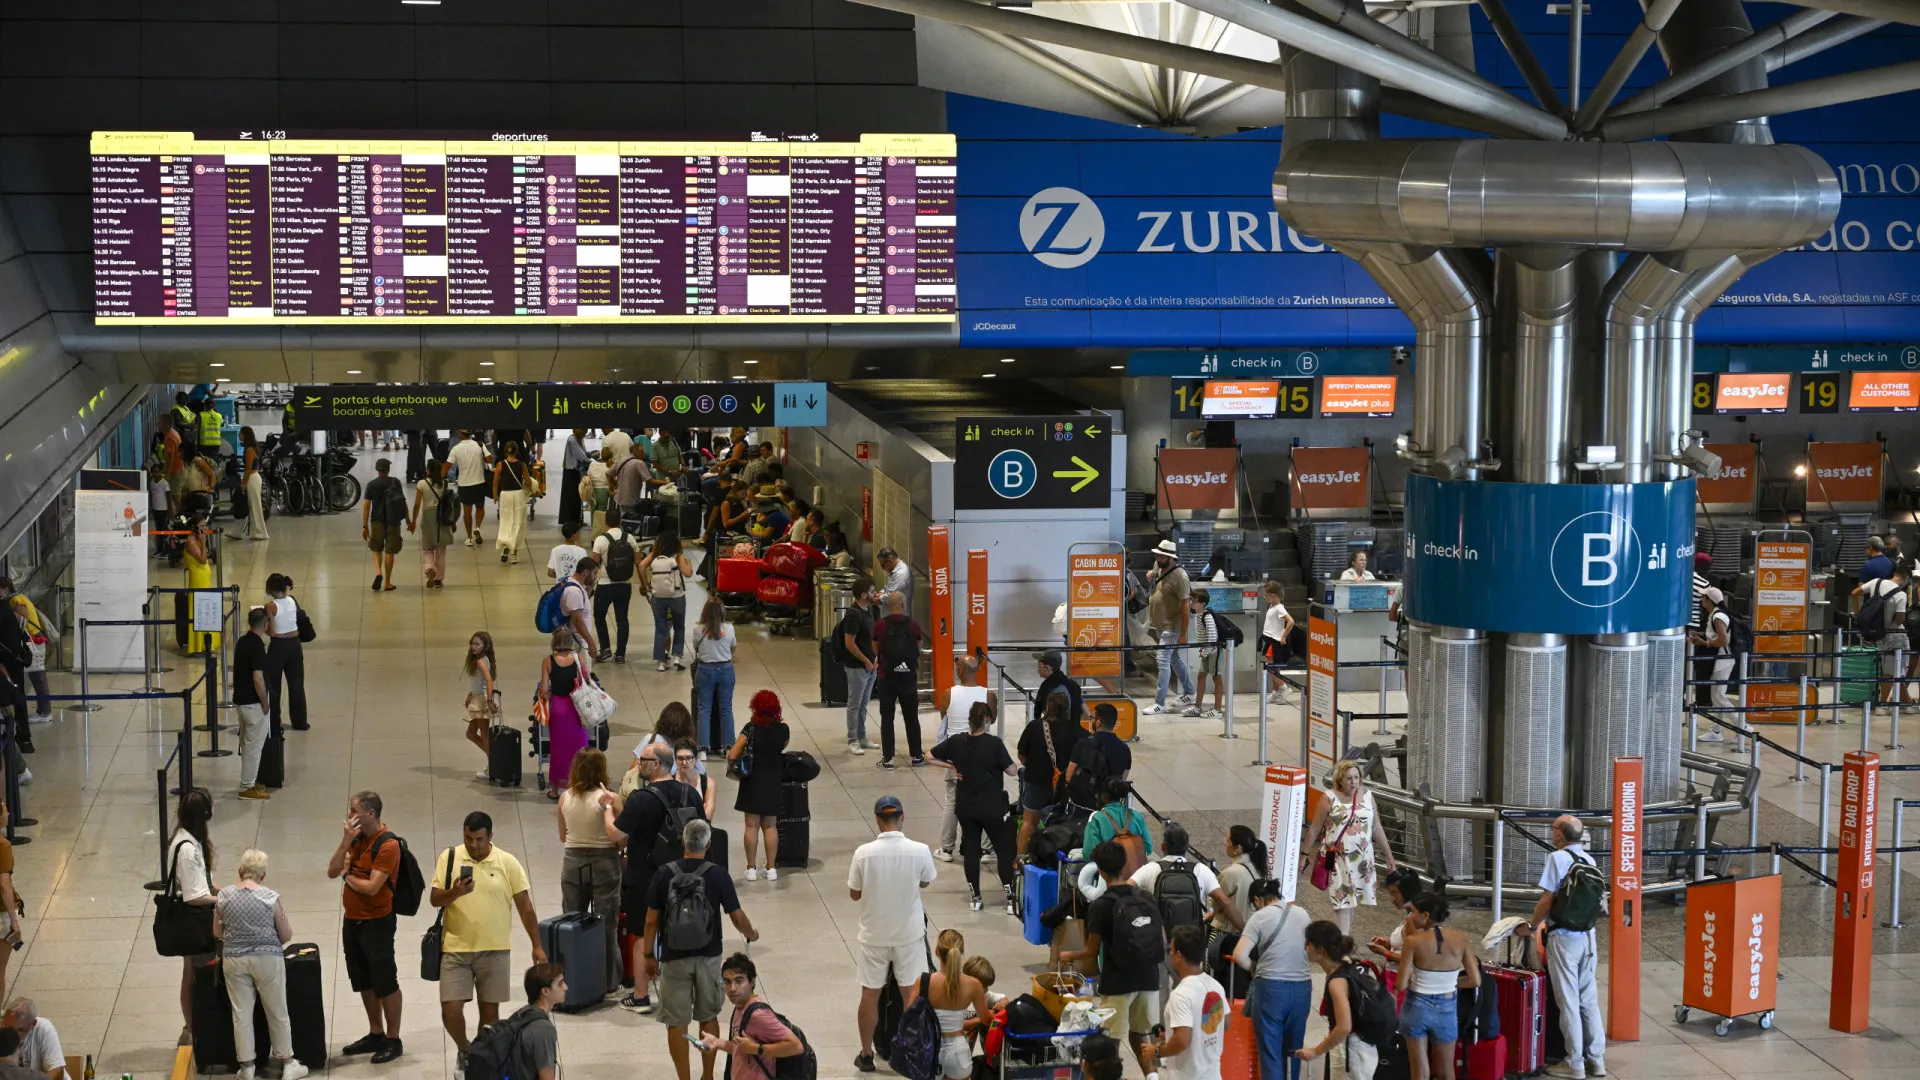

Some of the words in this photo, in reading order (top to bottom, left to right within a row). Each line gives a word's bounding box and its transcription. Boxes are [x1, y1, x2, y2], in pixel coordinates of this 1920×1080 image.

[262, 131, 286, 140] 16:23
[492, 132, 548, 141] departures
[1136, 211, 1337, 252] ZURIC
[1025, 297, 1047, 306] Esta
[1051, 296, 1121, 308] comunicação
[1125, 296, 1130, 305] é
[1134, 296, 1147, 305] da
[1150, 296, 1182, 305] inteira
[1185, 296, 1274, 307] responsabilidade
[1278, 296, 1290, 305] da
[1293, 295, 1328, 305] Zurich
[1332, 295, 1384, 305] Insurance
[1718, 294, 1761, 304] Seguros
[1764, 294, 1790, 303] Vida,
[1818, 294, 1870, 304] registadas
[1887, 294, 1907, 302] ASF
[973, 322, 1016, 331] JCDecaux
[1231, 357, 1267, 368] check
[1271, 357, 1281, 367] in
[1303, 357, 1312, 370] B
[1841, 352, 1874, 362] check
[1878, 351, 1887, 361] in
[1907, 351, 1916, 364] B
[1280, 386, 1308, 411] 15
[1722, 384, 1785, 399] easyJet
[1804, 382, 1836, 407] 19
[332, 396, 369, 407] portas
[373, 395, 386, 404] de
[389, 395, 448, 406] embarque
[580, 399, 613, 410] check
[616, 399, 627, 409] in
[1326, 399, 1368, 409] easyJet
[1371, 399, 1390, 408] plus
[333, 405, 382, 418] boarding
[384, 407, 415, 418] gates
[991, 427, 1022, 436] check
[1025, 426, 1035, 436] in
[1004, 461, 1023, 488] B
[1166, 471, 1227, 486] easyJet
[1300, 471, 1360, 486] easyJet
[1816, 465, 1872, 480] easyJet
[1424, 541, 1460, 559] check
[1465, 545, 1478, 561] in
[1075, 559, 1096, 568] CABIN
[1098, 559, 1117, 568] BAGS
[1582, 533, 1617, 587] B
[936, 567, 948, 596] SAIDA
[972, 593, 985, 615] EXIT
[1310, 632, 1335, 647] easyJet
[1267, 772, 1289, 780] easyJet
[1846, 769, 1860, 802] DROP
[1621, 781, 1636, 832] BOARDING
[1271, 789, 1281, 843] ASSISTANCE
[1844, 804, 1858, 828] BAG
[1866, 814, 1874, 826] DE
[1621, 834, 1636, 873] SPEEDY
[1702, 910, 1717, 998] easyJet
[1748, 912, 1764, 1000] easyJet
